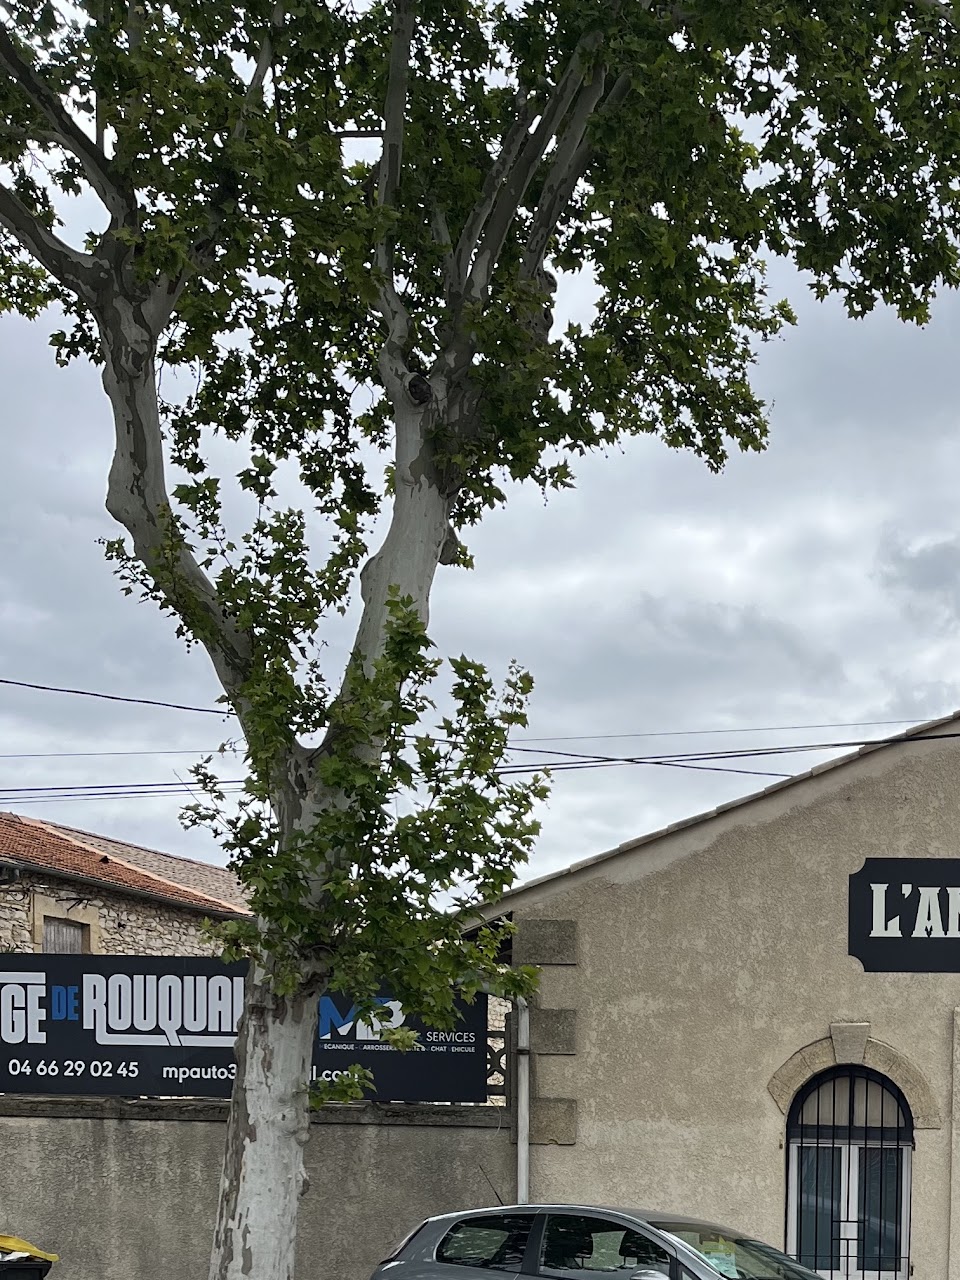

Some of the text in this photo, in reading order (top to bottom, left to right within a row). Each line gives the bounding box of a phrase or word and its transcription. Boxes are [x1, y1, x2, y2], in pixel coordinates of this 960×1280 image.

[52, 985, 79, 1020] DE
[426, 1031, 476, 1043] SERVICES
[8, 1059, 32, 1075] 04
[36, 1059, 59, 1076] 66
[63, 1060, 86, 1076] 29
[90, 1060, 113, 1077] 02
[117, 1061, 139, 1077] 45
